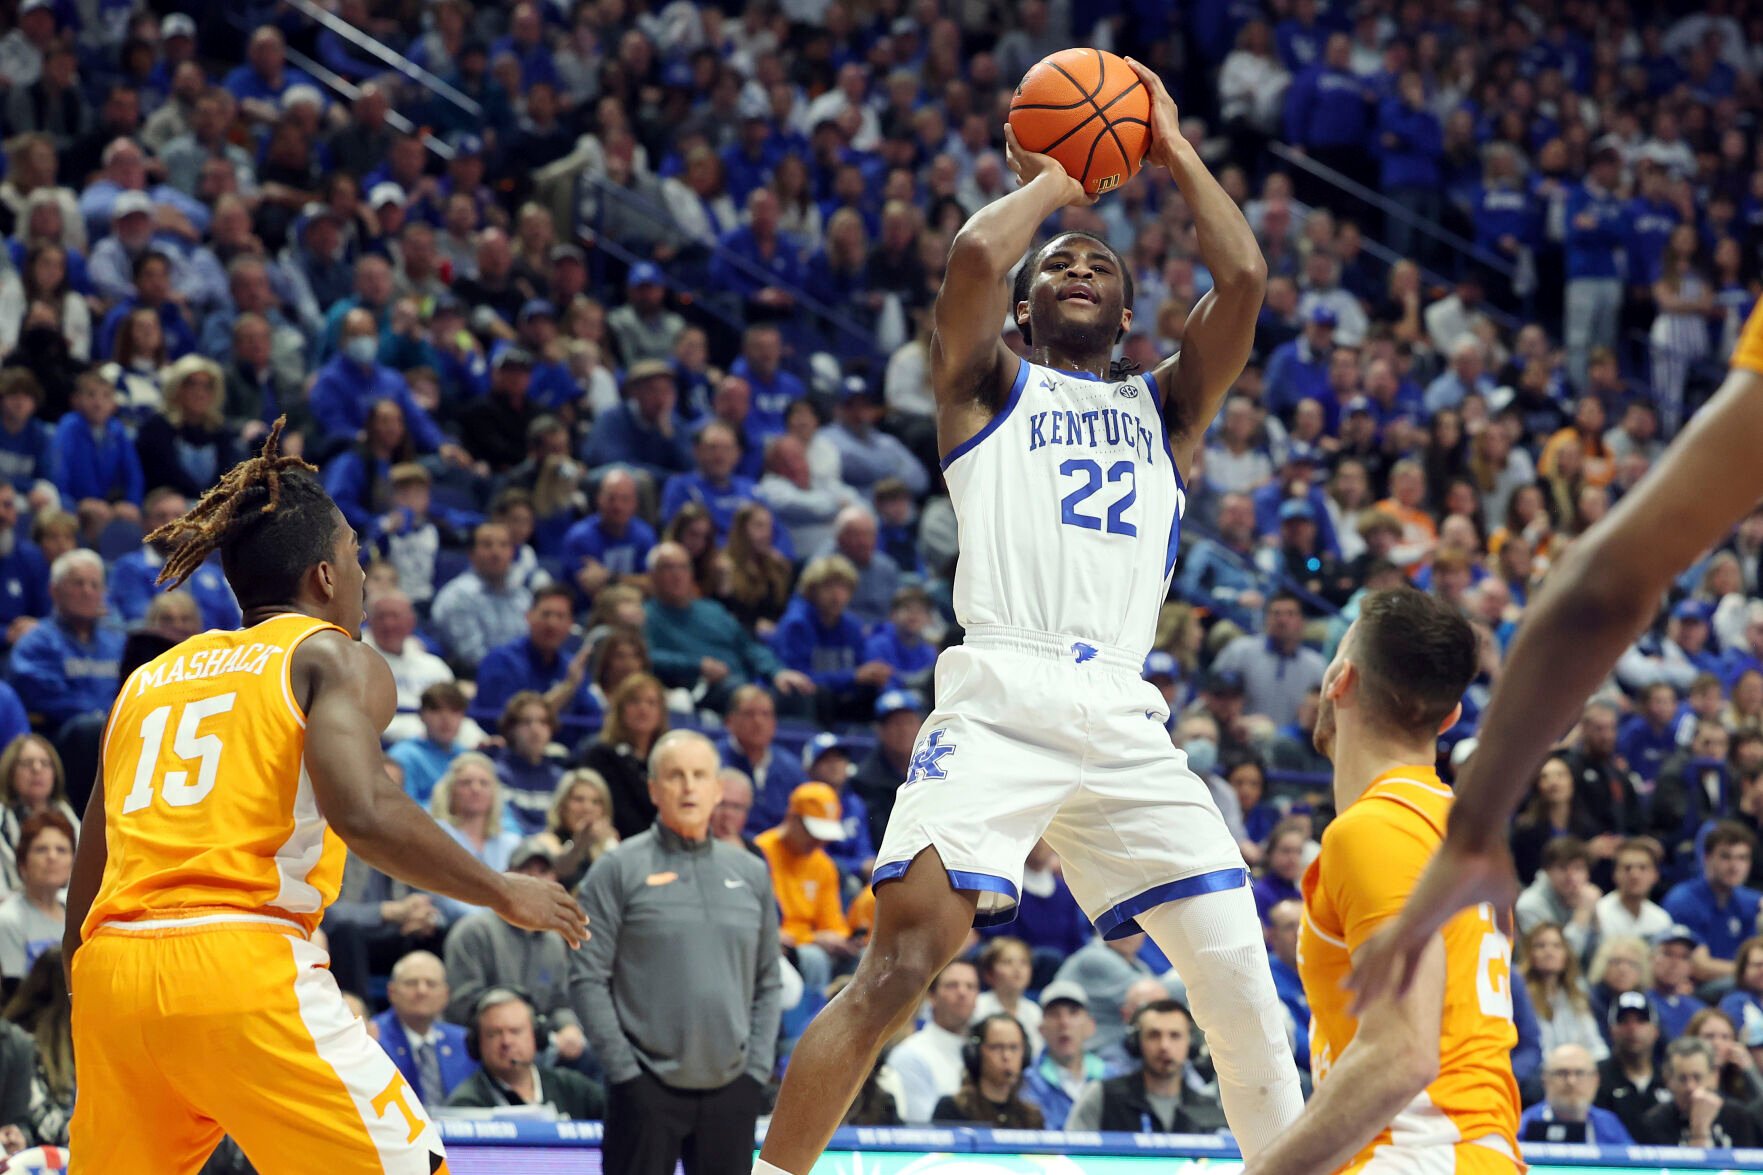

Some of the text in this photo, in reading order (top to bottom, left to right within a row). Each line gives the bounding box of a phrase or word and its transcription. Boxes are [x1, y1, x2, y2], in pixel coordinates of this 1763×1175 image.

[1120, 385, 1138, 398] SEC
[1059, 459, 1137, 538] 22
[136, 643, 284, 697] MASHACK
[122, 692, 237, 815] 15
[370, 1070, 426, 1145] T
